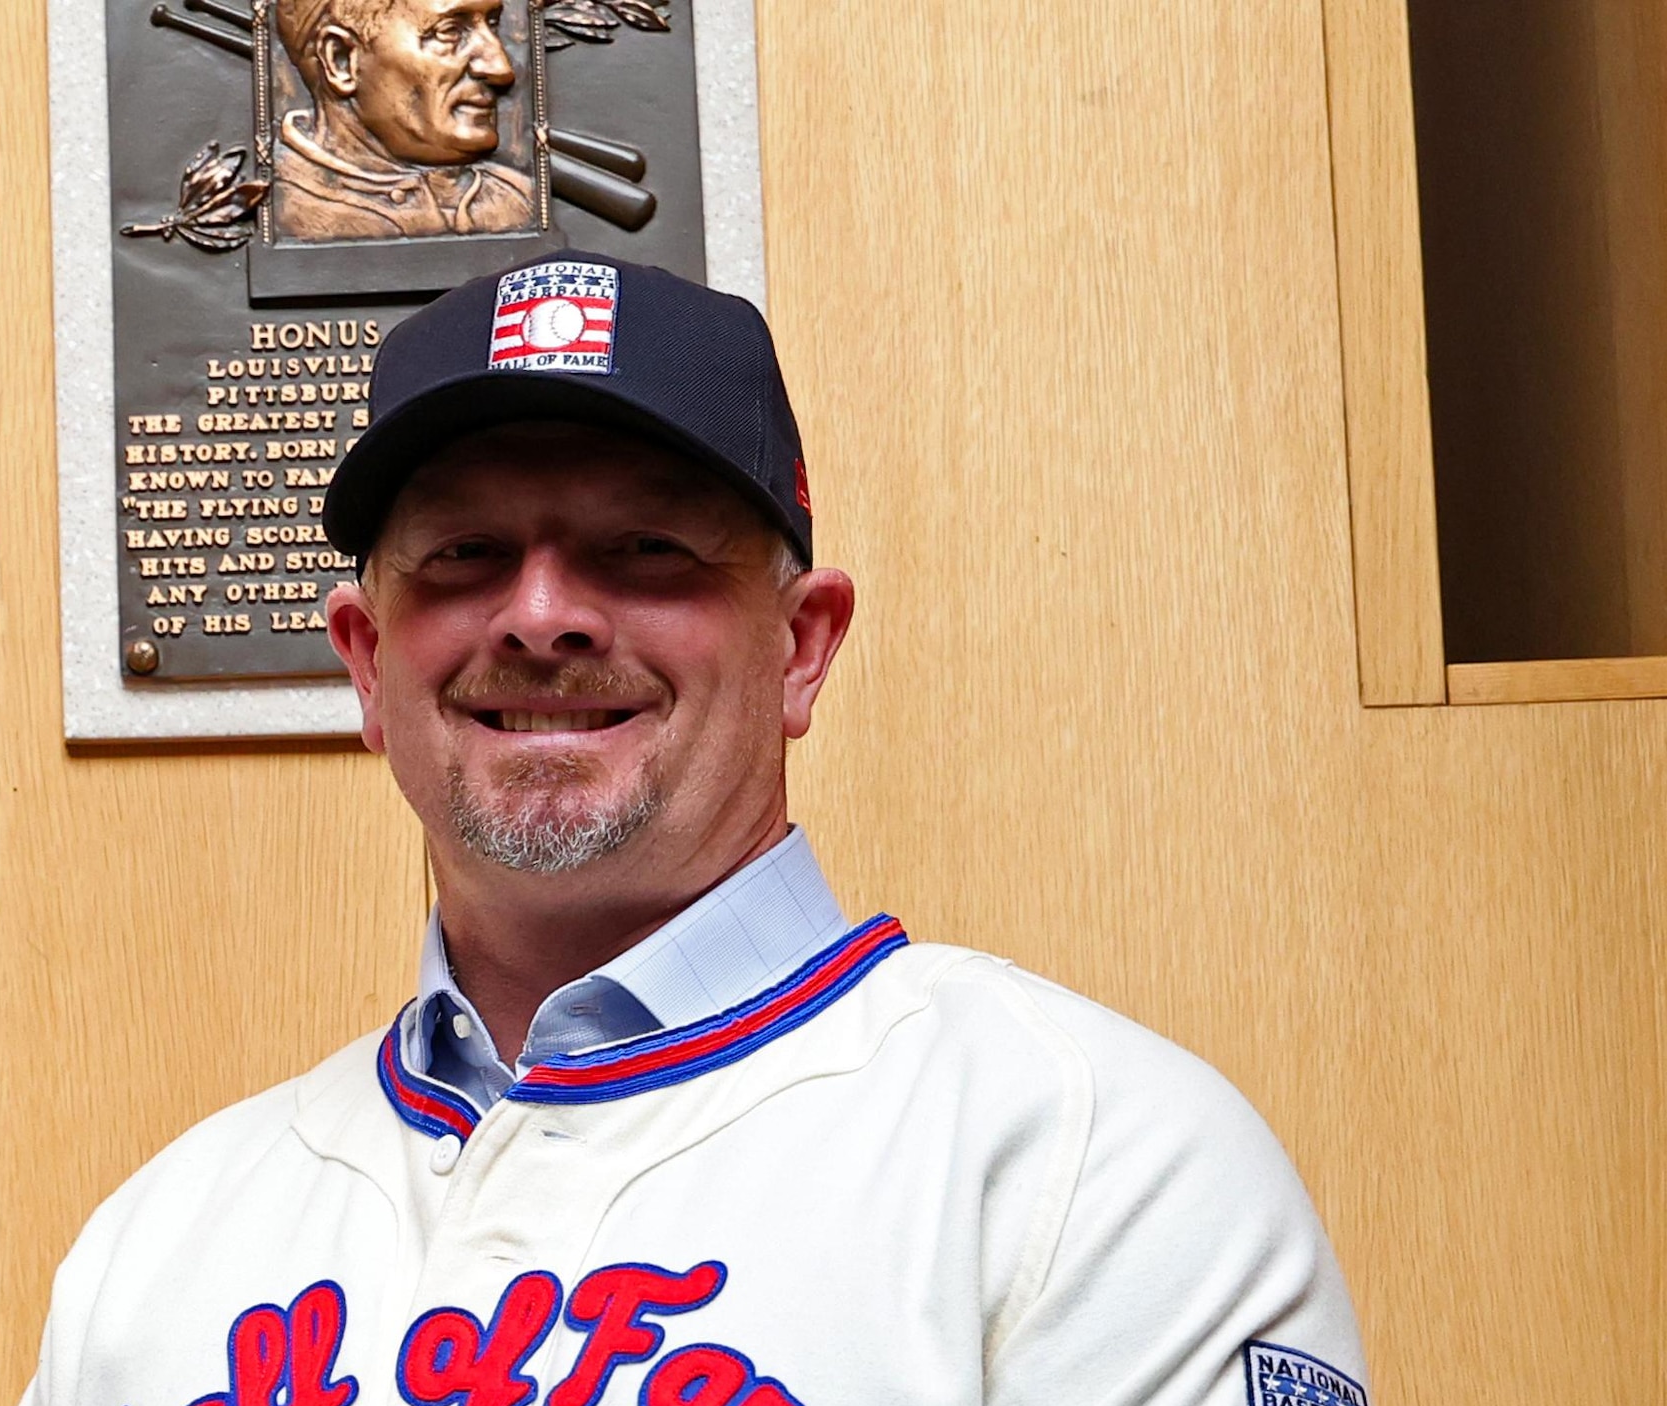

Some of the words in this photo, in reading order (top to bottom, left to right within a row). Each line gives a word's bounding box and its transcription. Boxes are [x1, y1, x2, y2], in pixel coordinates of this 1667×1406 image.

[504, 264, 613, 283] NATIONAL
[501, 287, 611, 305] BASEBALL
[251, 320, 381, 350] HONUS
[536, 354, 557, 367] OF
[563, 354, 609, 368] FAME
[128, 414, 182, 435] THE
[197, 410, 337, 433] GREATEST
[125, 441, 259, 465] HISTORY.
[265, 439, 337, 461] BORN
[129, 470, 230, 491] KNOWN
[242, 469, 275, 489] TO
[123, 496, 188, 520] "THE
[200, 496, 299, 519] FLYING
[126, 527, 231, 549] HAVING
[140, 557, 208, 578] HITS
[218, 553, 276, 573] AND
[145, 585, 208, 605] ANY
[226, 581, 319, 602] OTHER
[152, 614, 187, 635] OF
[203, 613, 252, 634] HIS
